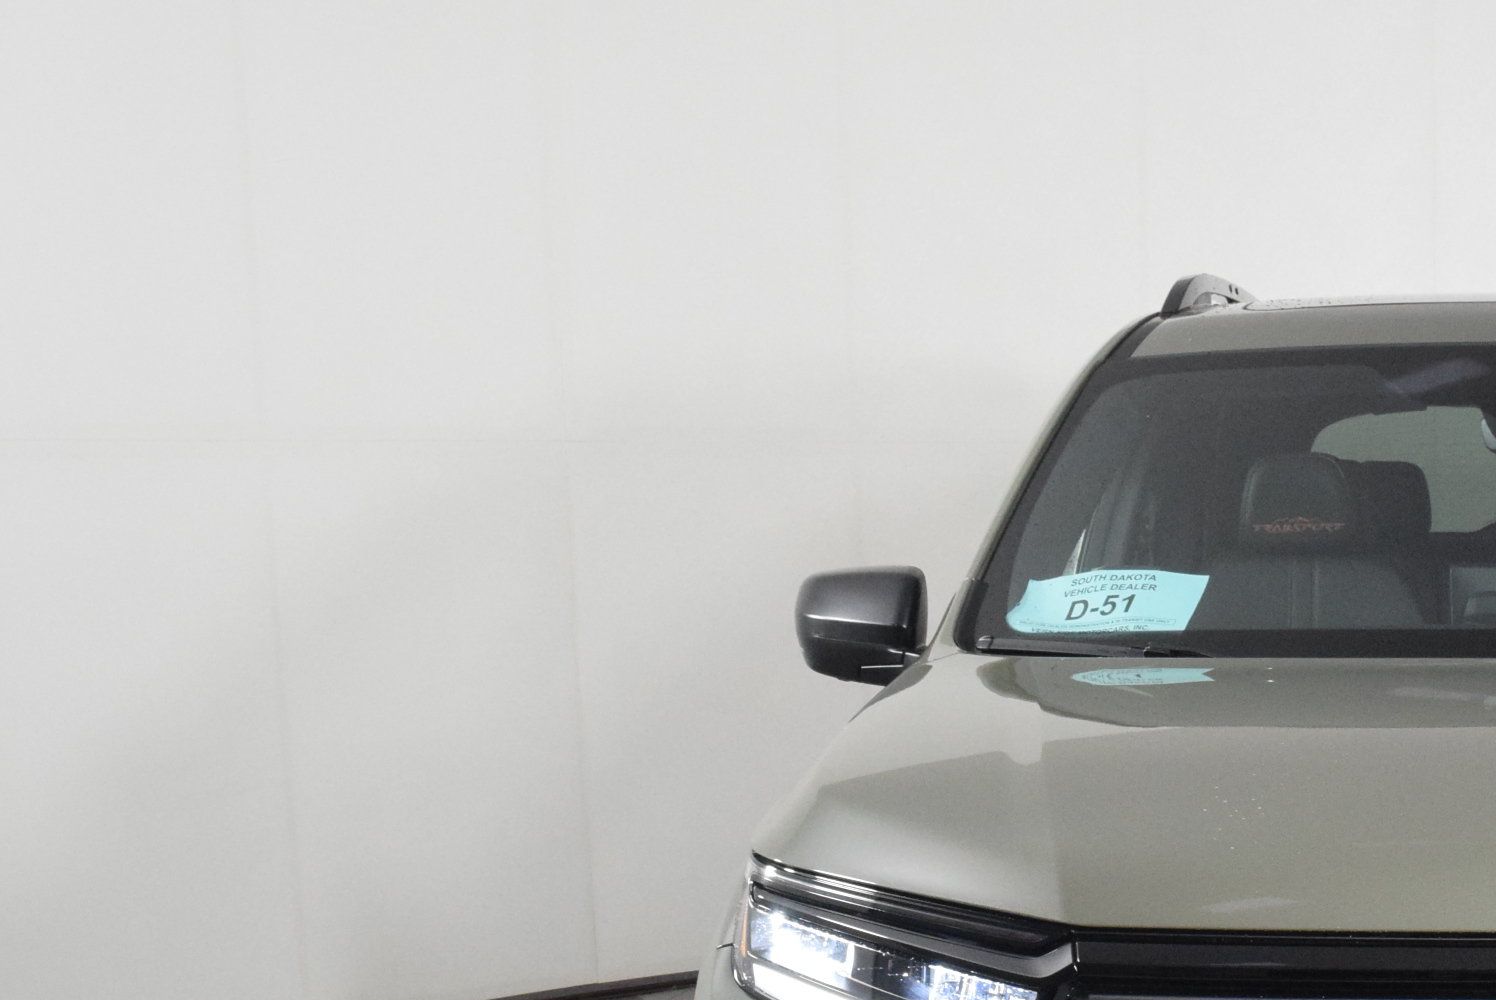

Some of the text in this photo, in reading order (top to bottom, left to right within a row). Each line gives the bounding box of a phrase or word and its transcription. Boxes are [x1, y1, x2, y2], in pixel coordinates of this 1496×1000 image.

[1071, 574, 1107, 587] SOUTH
[1064, 583, 1158, 598] VEHICLE DEALER
[1065, 594, 1136, 620] D-51
